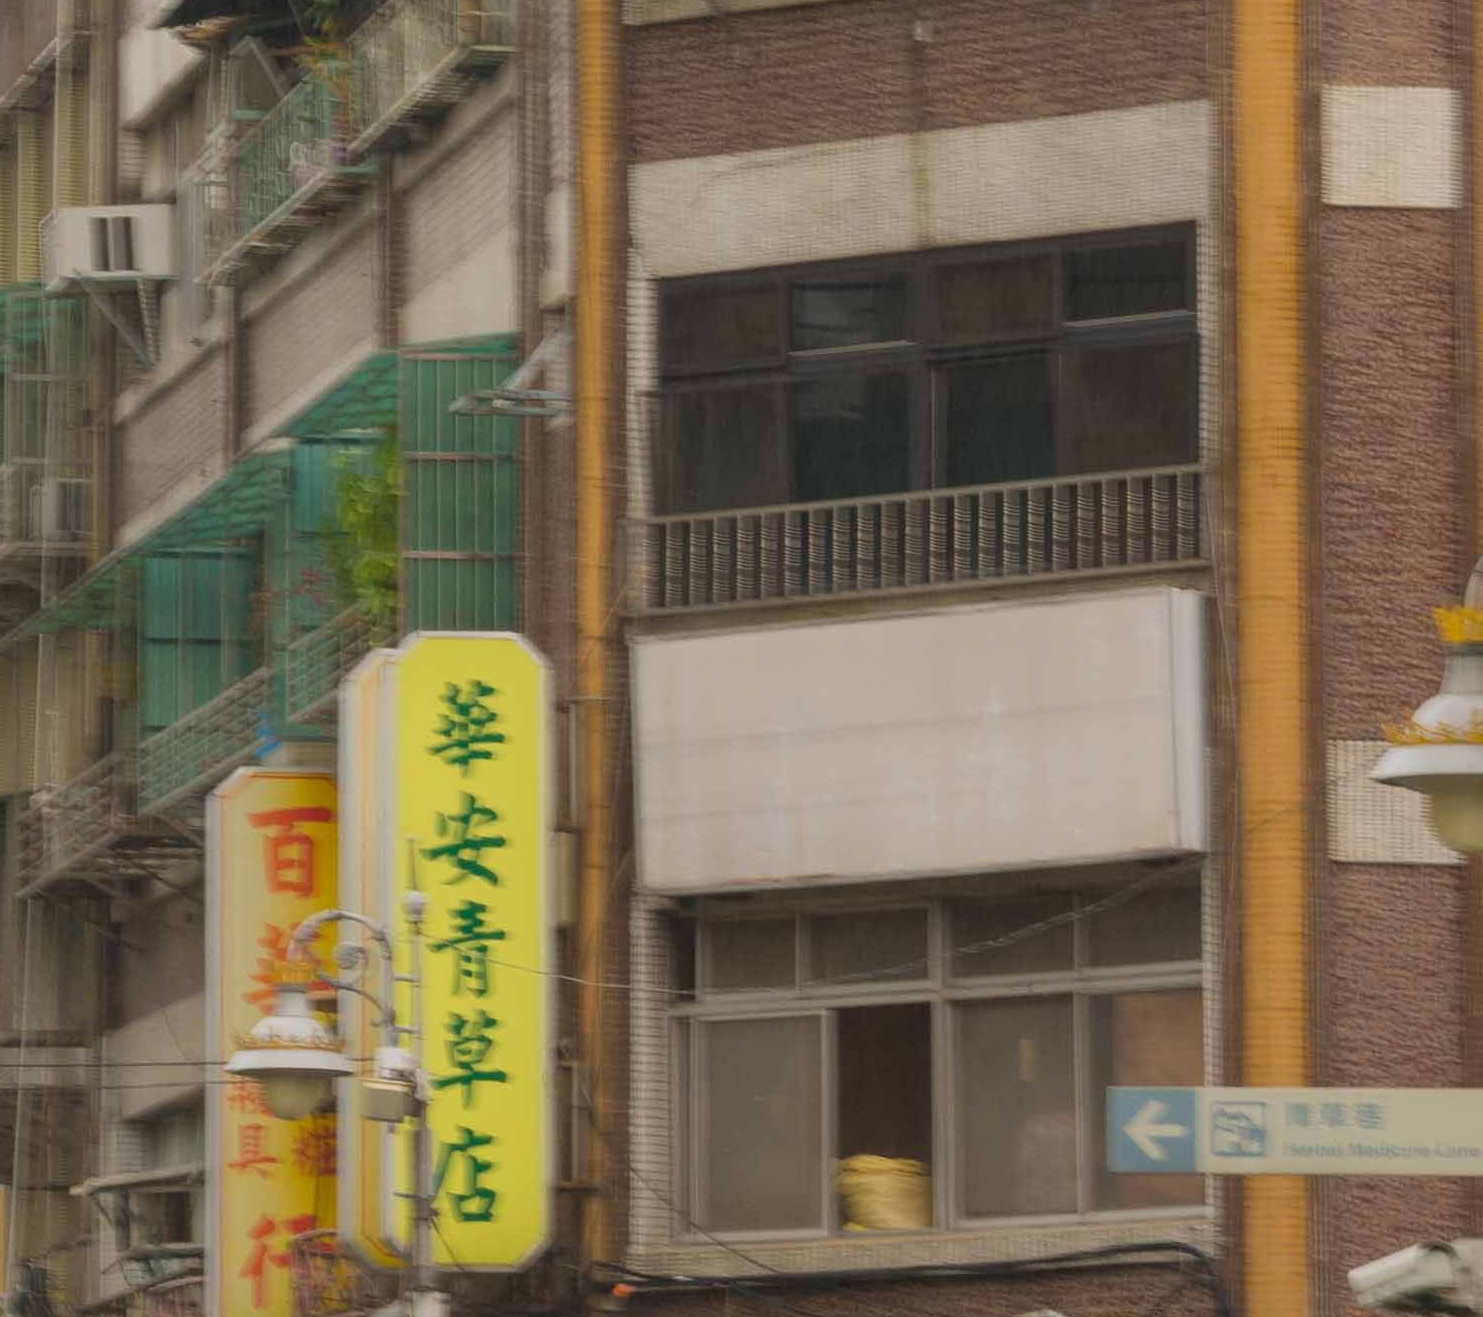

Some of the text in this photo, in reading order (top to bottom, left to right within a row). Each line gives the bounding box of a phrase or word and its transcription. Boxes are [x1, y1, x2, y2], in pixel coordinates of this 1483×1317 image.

[419, 679, 508, 1225] 華安青草店
